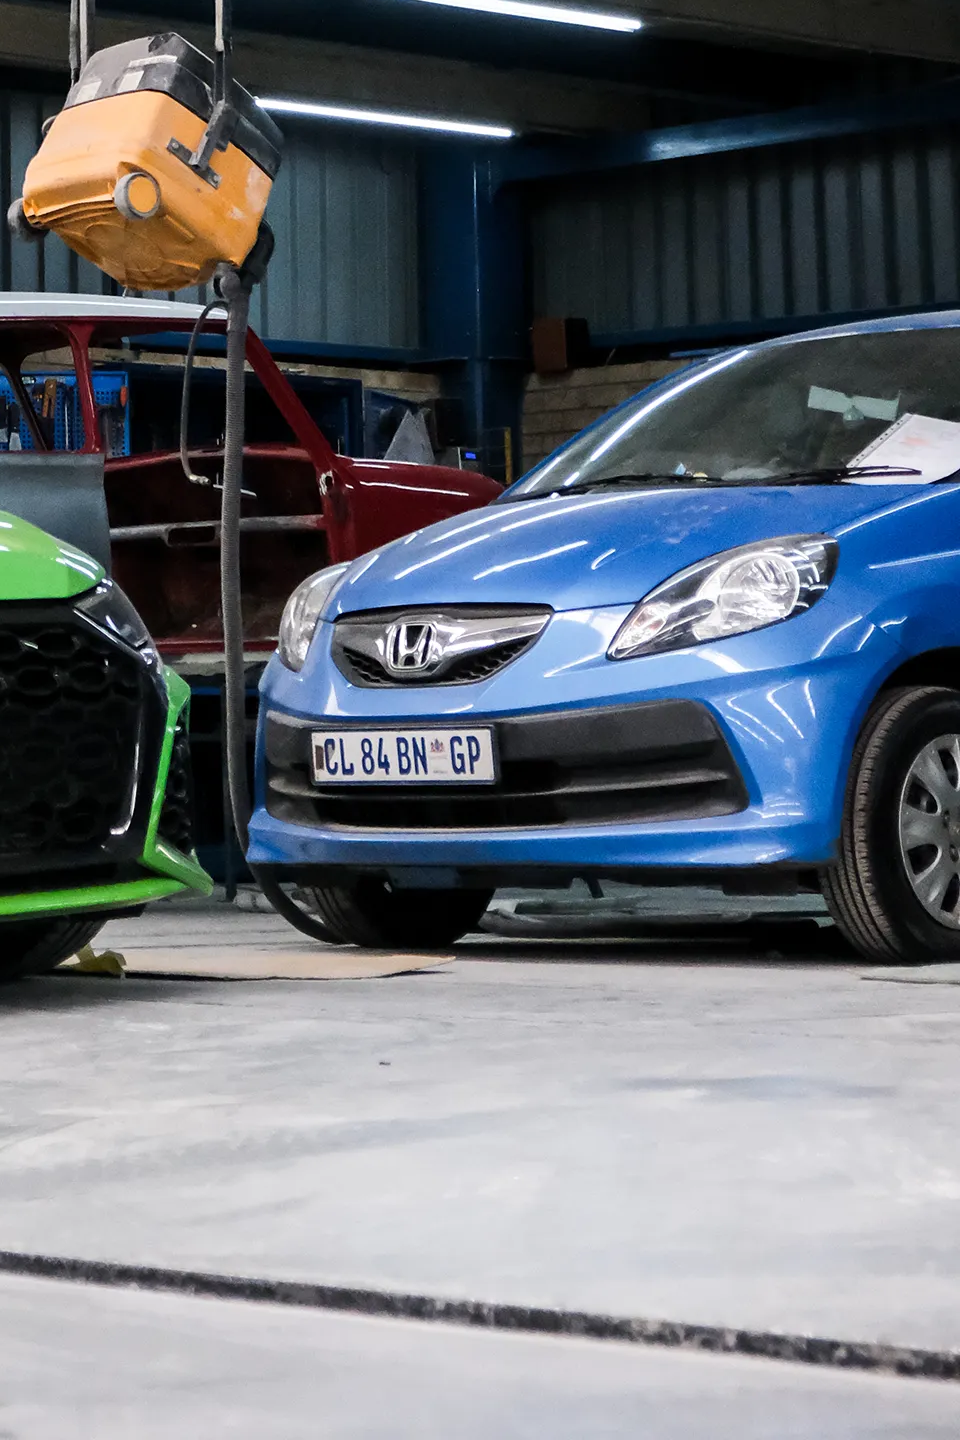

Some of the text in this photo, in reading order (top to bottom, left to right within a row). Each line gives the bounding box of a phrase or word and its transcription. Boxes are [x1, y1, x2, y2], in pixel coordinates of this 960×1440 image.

[323, 735, 481, 776] CL 84 BN GP
